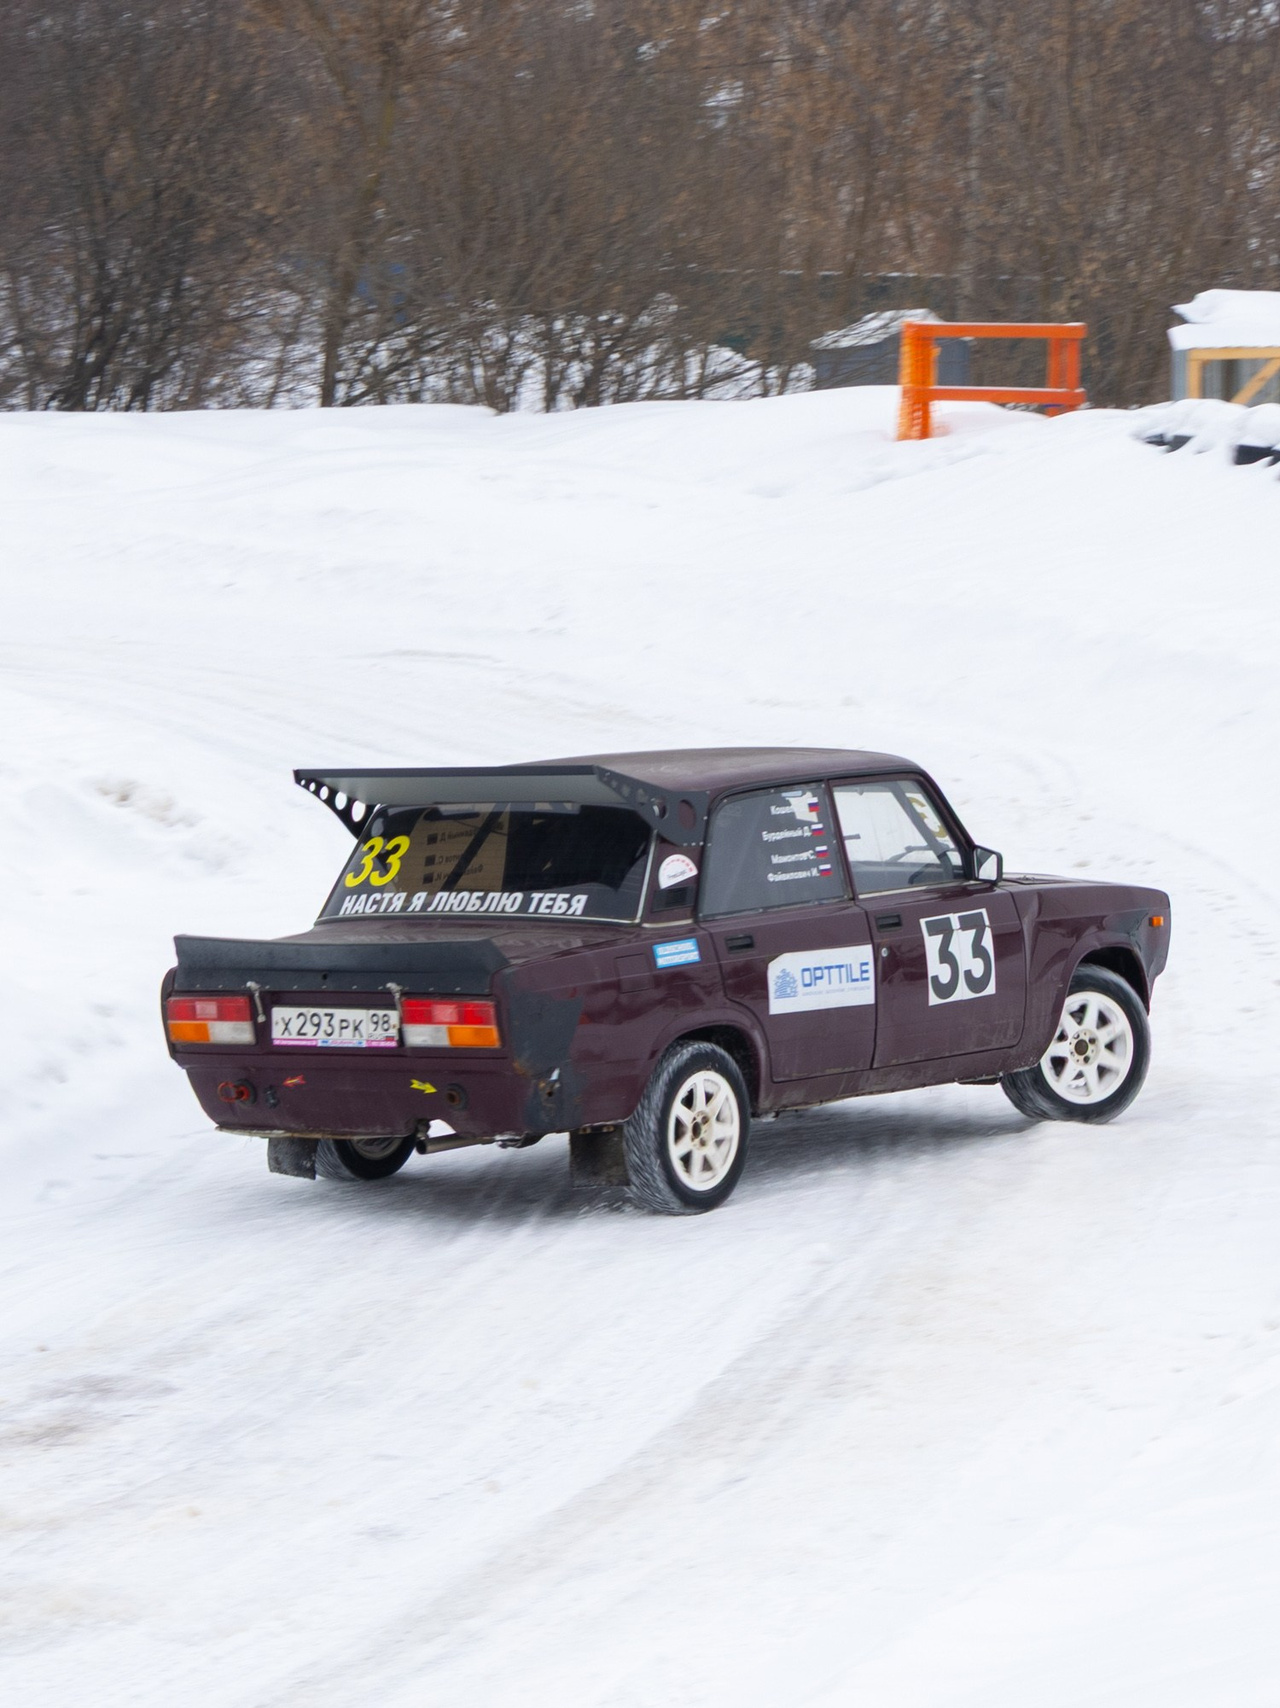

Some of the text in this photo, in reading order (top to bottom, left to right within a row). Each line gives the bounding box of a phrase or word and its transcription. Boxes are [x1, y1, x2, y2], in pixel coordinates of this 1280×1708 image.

[344, 835, 411, 888] 33
[339, 891, 588, 916] НАСТЯ Я ЛЮБЛЮ ТЕБЯ
[925, 910, 993, 1000] 33
[801, 961, 870, 988] OPTTILE
[370, 1012, 391, 1032] 98
